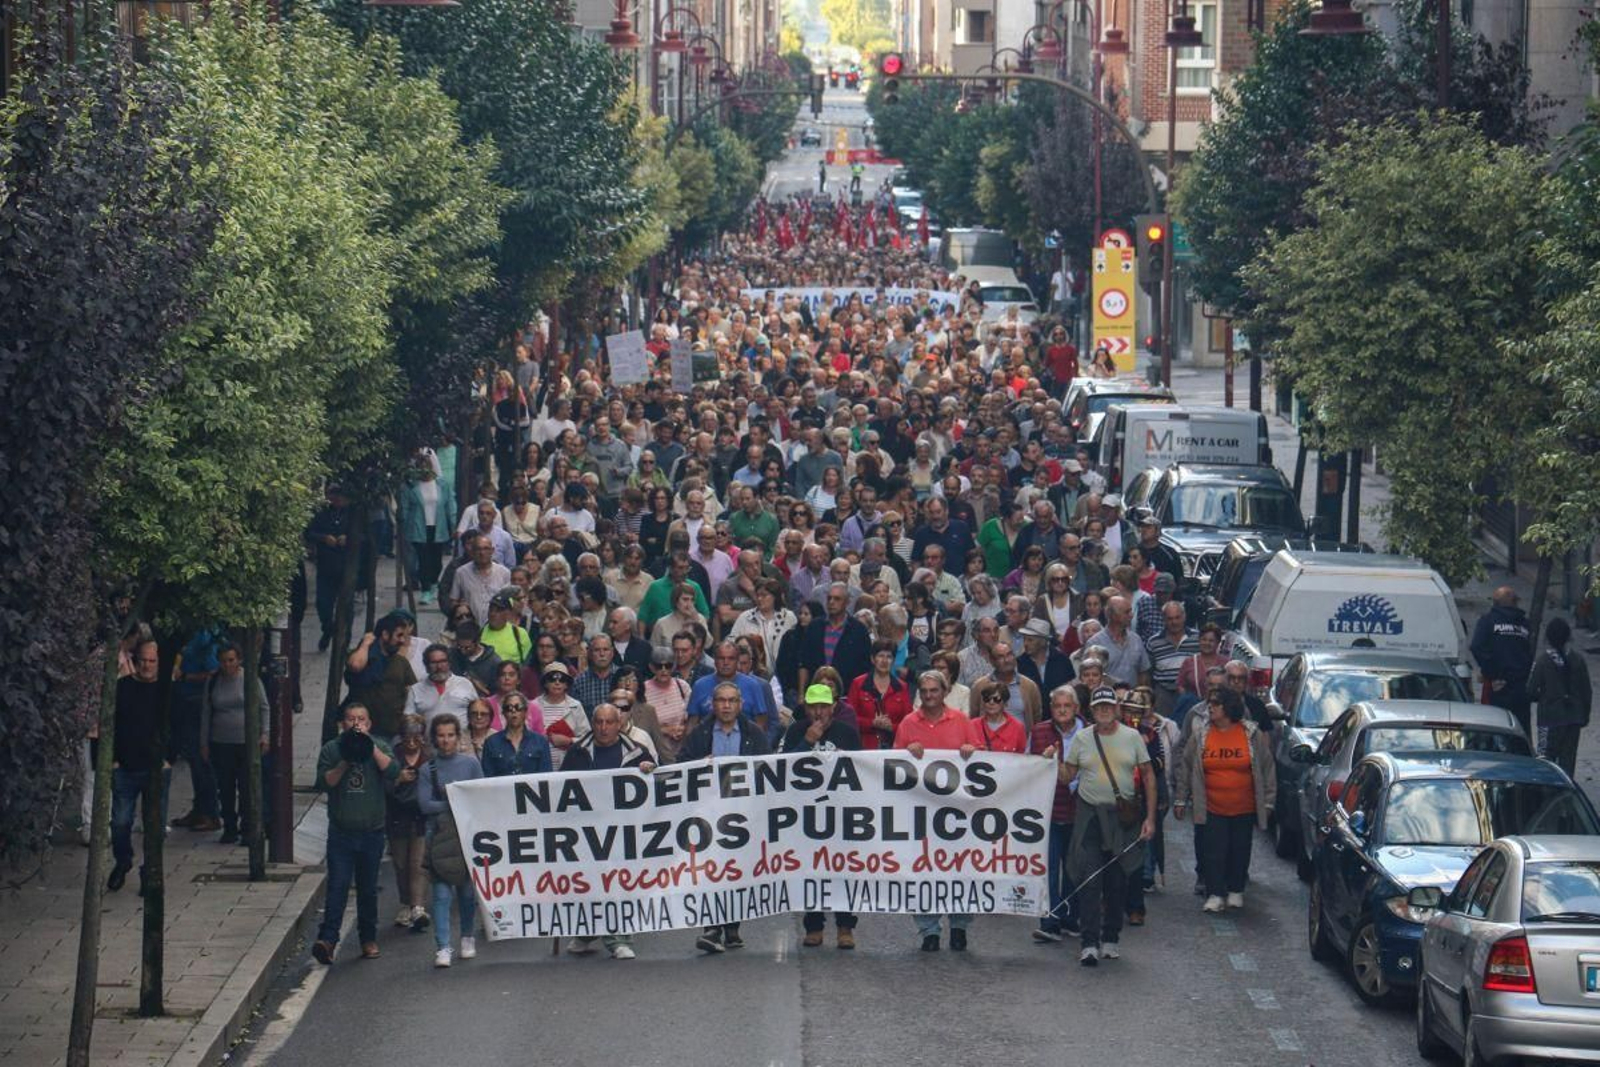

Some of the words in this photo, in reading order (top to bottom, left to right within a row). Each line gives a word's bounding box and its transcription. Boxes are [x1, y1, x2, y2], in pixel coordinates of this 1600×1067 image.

[1146, 429, 1173, 451] M
[1177, 437, 1205, 447] RENT
[1217, 439, 1239, 448] CAR
[1332, 619, 1394, 634] TREVAL
[515, 778, 593, 815] NA
[612, 757, 862, 810] DEFENSA
[883, 758, 997, 797] DOS
[472, 813, 750, 867] SERVIZOS
[767, 795, 1045, 844] PÚBLICOS
[472, 856, 525, 901] Non
[536, 870, 591, 895] aos
[601, 843, 743, 893] recortes
[753, 840, 802, 877] dos
[813, 846, 900, 874] nosos
[912, 835, 1047, 875] dereitos
[521, 896, 673, 937] PLATAFORMA
[684, 880, 790, 927] SANITARIA
[803, 878, 832, 911] DE
[844, 879, 996, 914] VALDEORRAS
